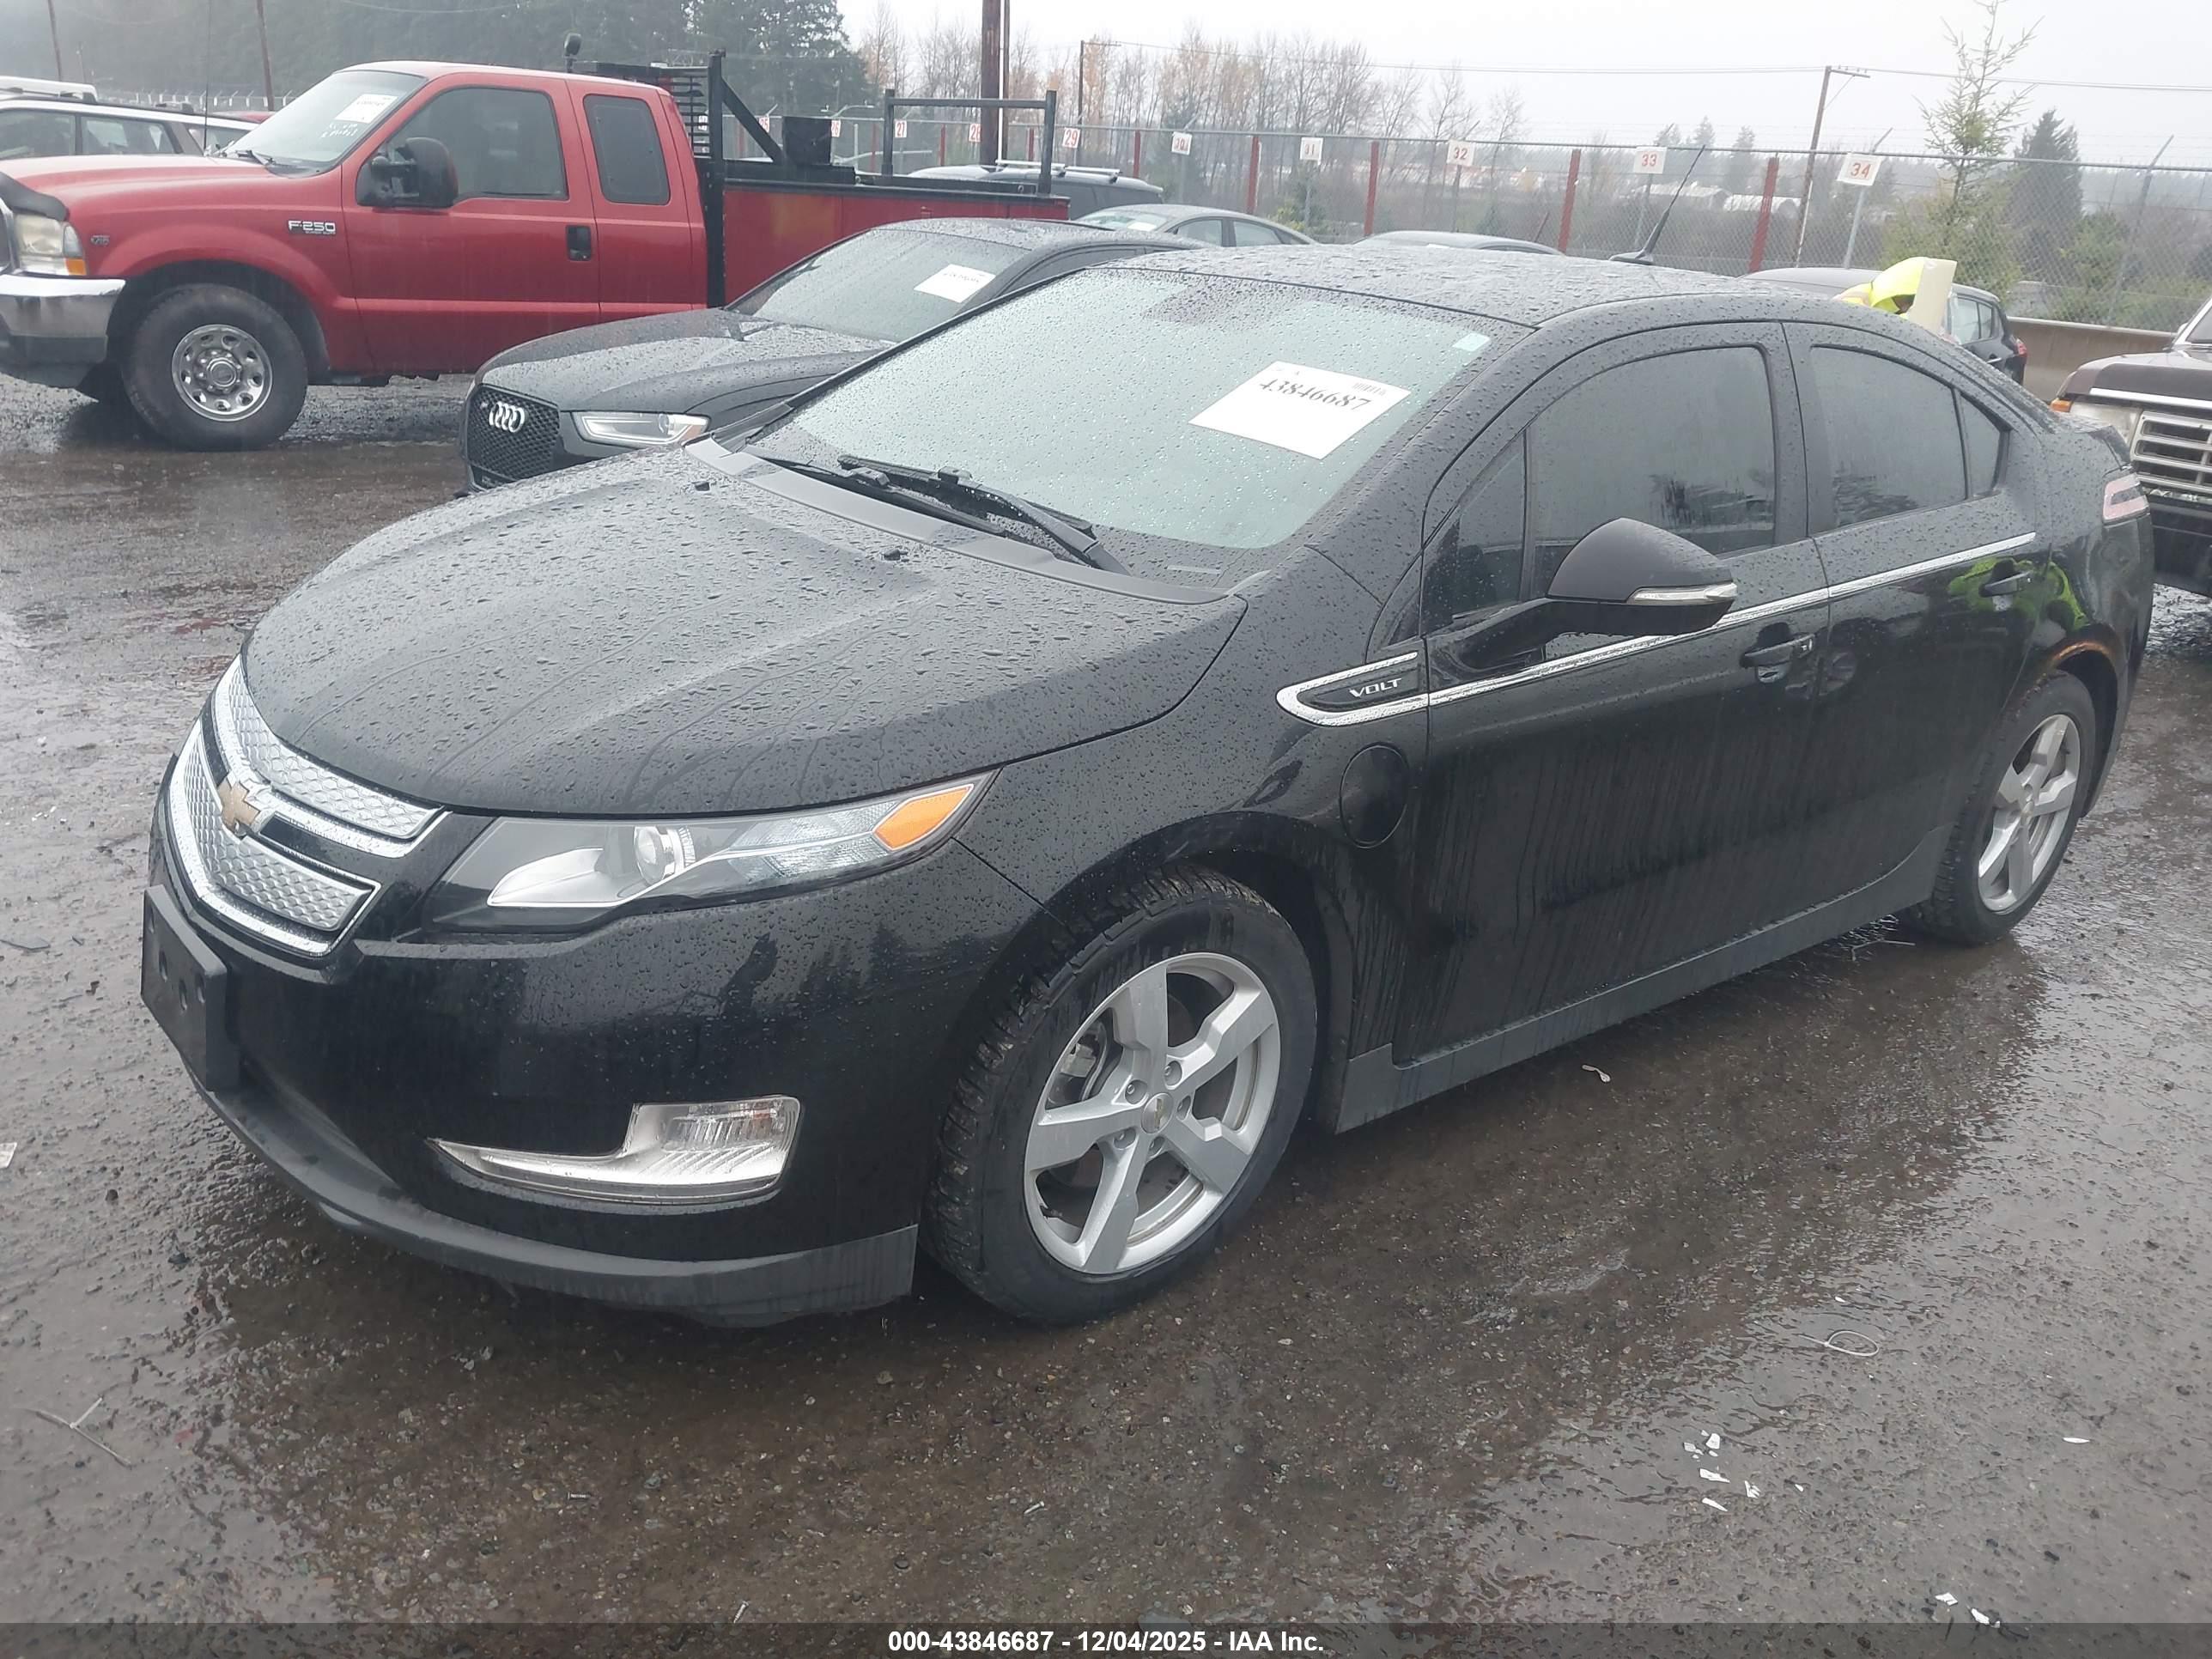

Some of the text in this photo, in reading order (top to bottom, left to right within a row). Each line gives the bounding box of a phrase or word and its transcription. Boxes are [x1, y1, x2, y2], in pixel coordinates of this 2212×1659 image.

[896, 122, 906, 137] 27
[1065, 129, 1079, 146] 29
[1304, 143, 1316, 155] 31
[1454, 147, 1468, 160] 32
[1641, 154, 1657, 167] 33
[1850, 162, 1871, 178] 34
[1260, 378, 1372, 410] 43846687
[1348, 678, 1402, 698] VOLT
